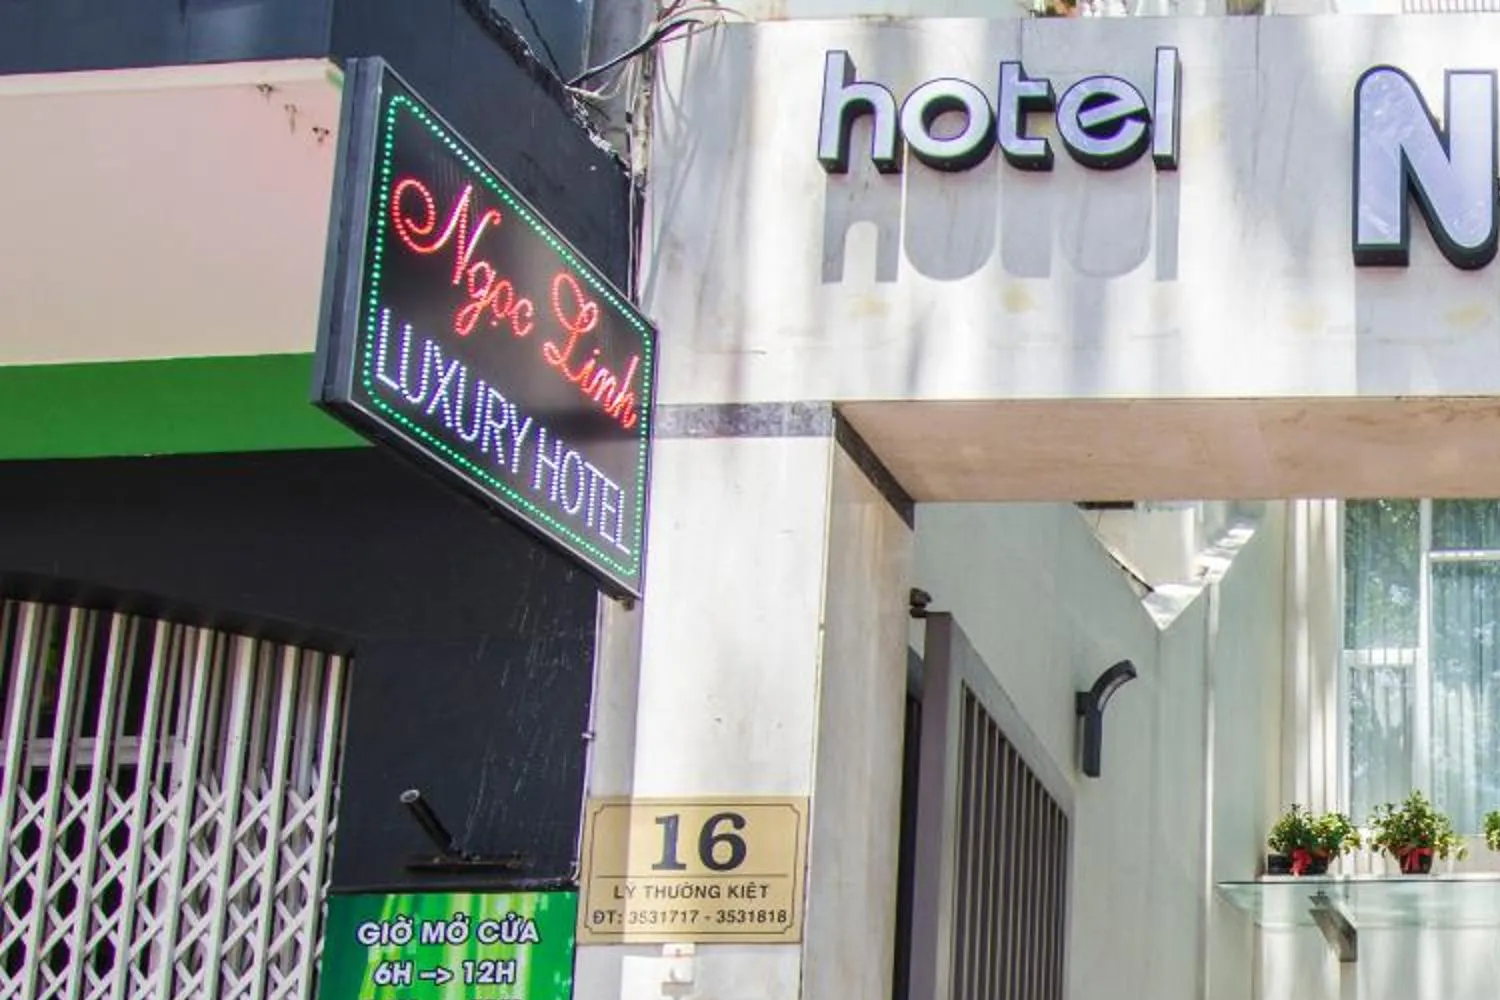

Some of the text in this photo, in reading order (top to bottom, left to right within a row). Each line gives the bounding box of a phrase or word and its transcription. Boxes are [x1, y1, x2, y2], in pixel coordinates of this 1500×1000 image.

[818, 46, 1180, 173] hotel
[392, 179, 638, 430] Ngọc Linh
[375, 307, 630, 555] LUXURY HOTEL
[652, 811, 747, 871] 16
[357, 913, 540, 944] GIỜ MỞ CỬA
[593, 909, 623, 925] ĐT:
[628, 909, 699, 925] 3531717
[716, 909, 787, 924] 3531818
[374, 960, 516, 985] 6H 12H
